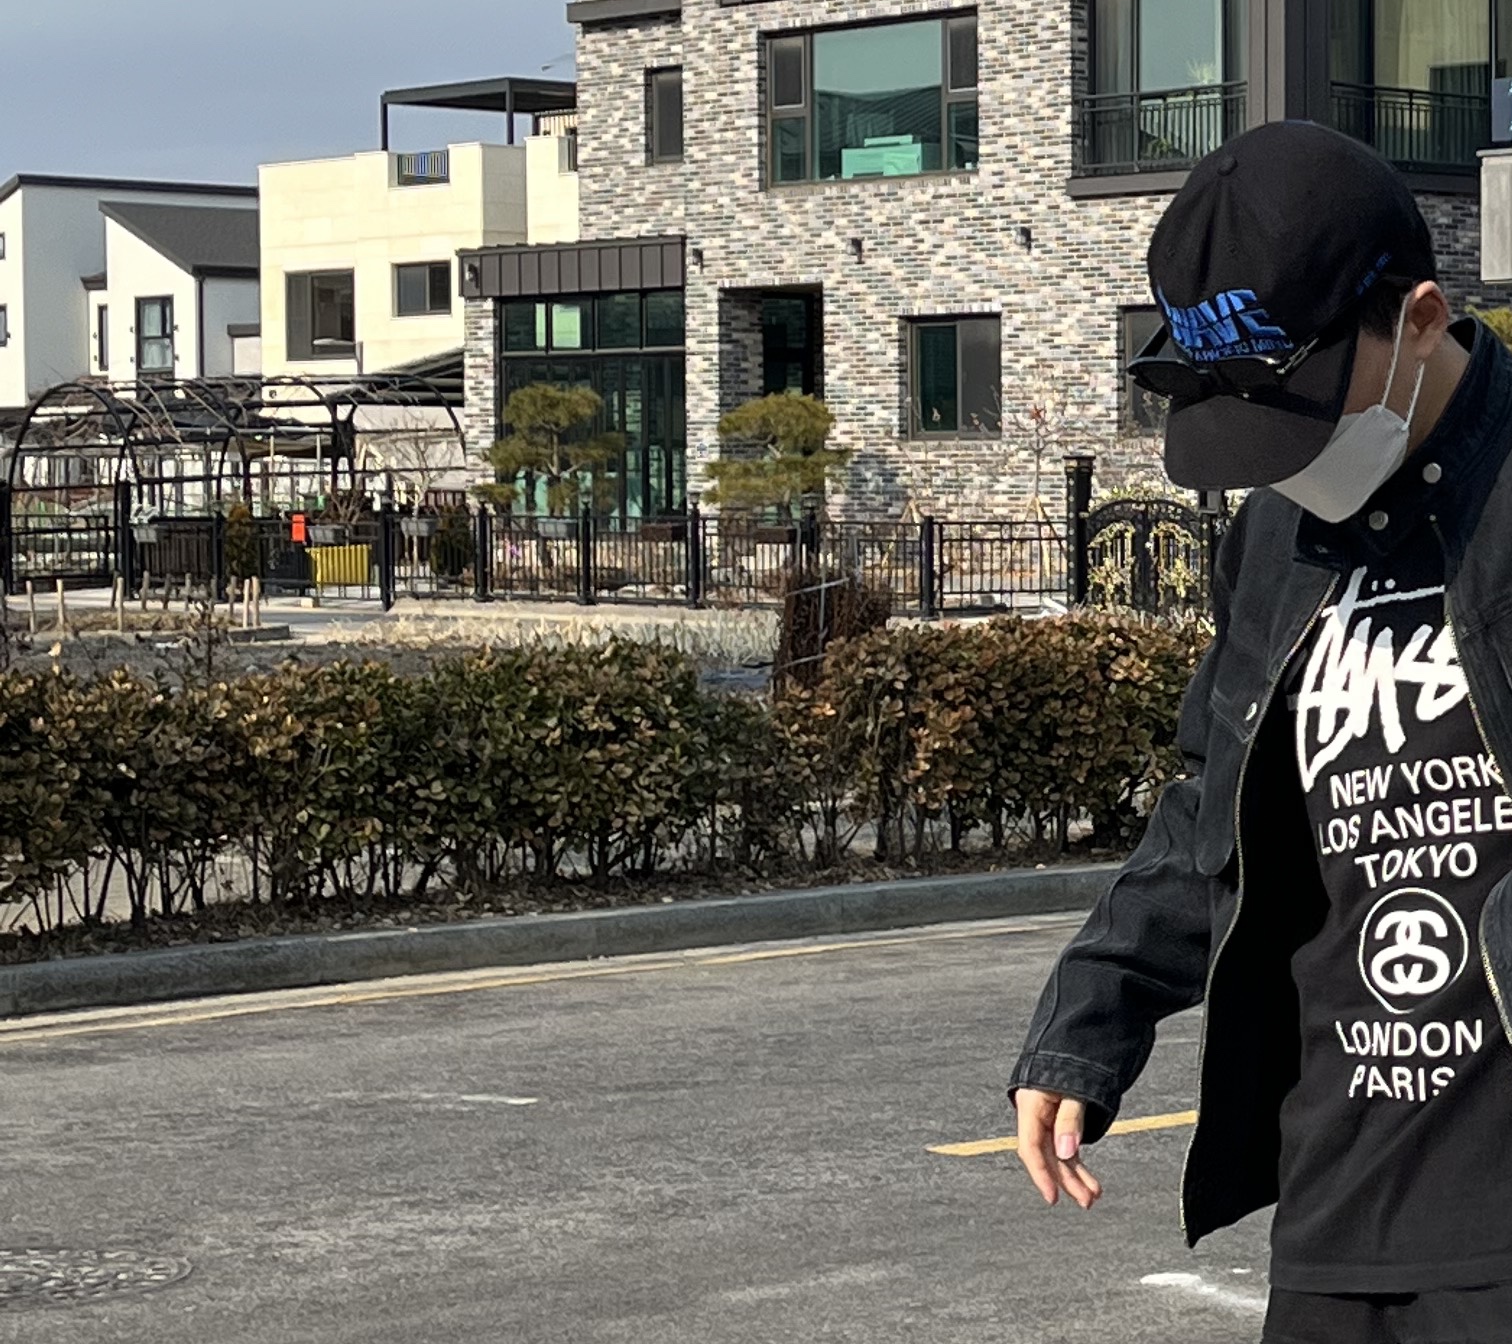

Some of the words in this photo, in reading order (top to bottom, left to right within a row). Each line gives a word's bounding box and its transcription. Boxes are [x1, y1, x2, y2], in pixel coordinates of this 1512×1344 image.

[1330, 764, 1393, 810] NEW
[1401, 753, 1504, 795] YORK
[1318, 813, 1361, 855] LOS
[1354, 842, 1479, 889] TOKYO
[1335, 1019, 1484, 1057] LONDON
[1348, 1063, 1456, 1103] PARIS
